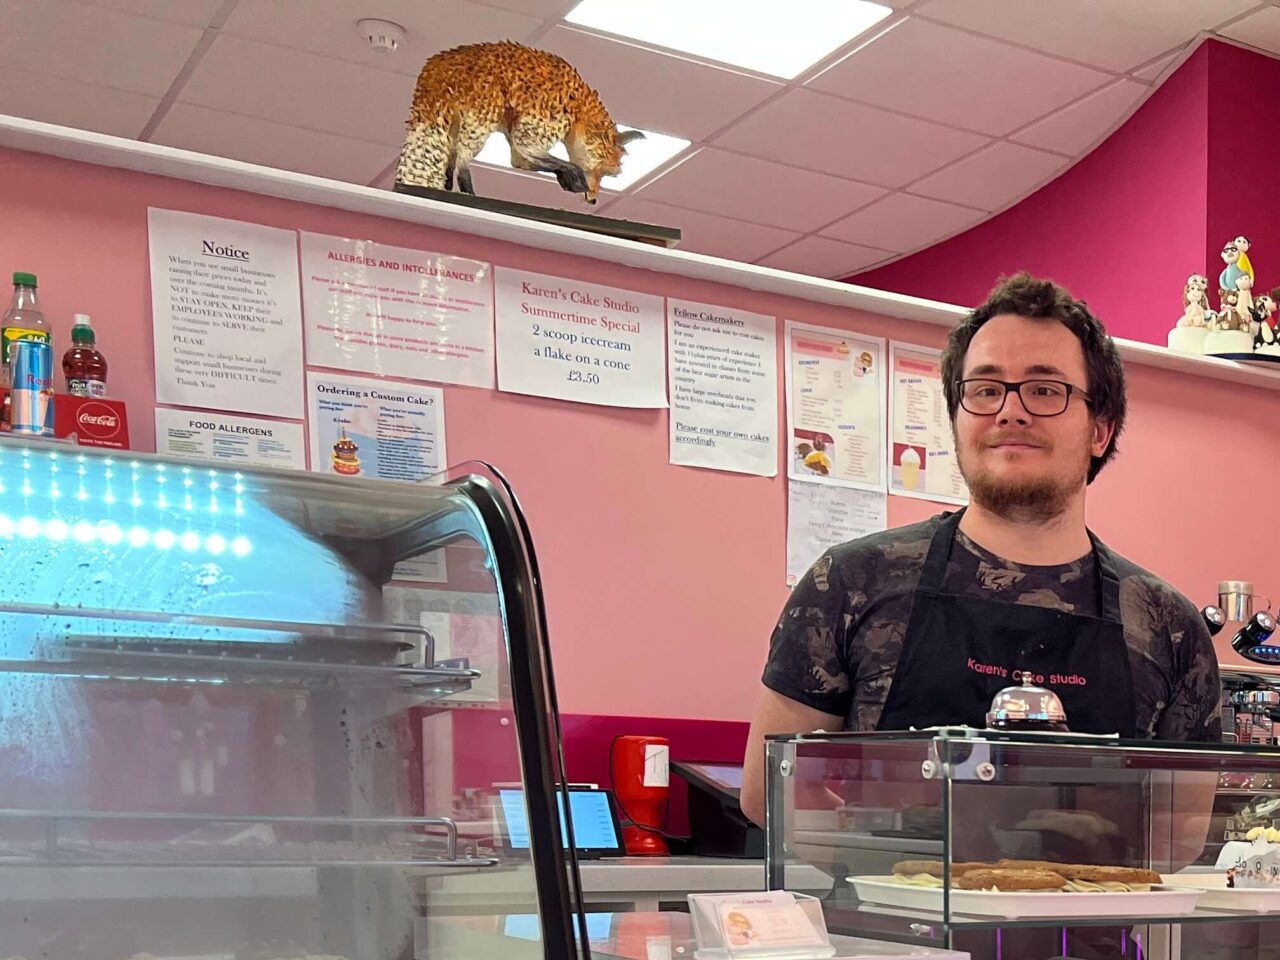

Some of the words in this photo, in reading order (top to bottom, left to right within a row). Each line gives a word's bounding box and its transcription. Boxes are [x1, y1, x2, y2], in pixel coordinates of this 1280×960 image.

[202, 240, 250, 260] Notice
[328, 252, 376, 267] ALLERGIES
[379, 260, 400, 270] AND
[522, 282, 566, 301] Karen's
[571, 291, 600, 306] Cake
[604, 297, 640, 314] Studio
[522, 303, 597, 326] Summertime
[601, 316, 640, 333] Special
[674, 308, 699, 318] Fellow
[700, 312, 745, 326] Cakemakers
[532, 324, 540, 336] 2
[543, 328, 577, 344] scoop
[581, 332, 631, 351] icecream
[534, 348, 540, 356] a
[544, 346, 572, 361] flake
[576, 354, 590, 364] on
[594, 357, 600, 366] a
[604, 360, 631, 371] cone
[567, 370, 600, 384] £3.50
[317, 385, 361, 398] Ordering
[371, 391, 404, 402] Custom
[407, 396, 434, 406] Cake?
[189, 421, 216, 430] FOOD
[218, 424, 272, 437] ALLERGENS
[676, 422, 698, 431] Please
[750, 433, 769, 442] cakes
[676, 435, 716, 447] accordingly
[967, 657, 1008, 678] Karen's
[1012, 670, 1044, 683] Cke
